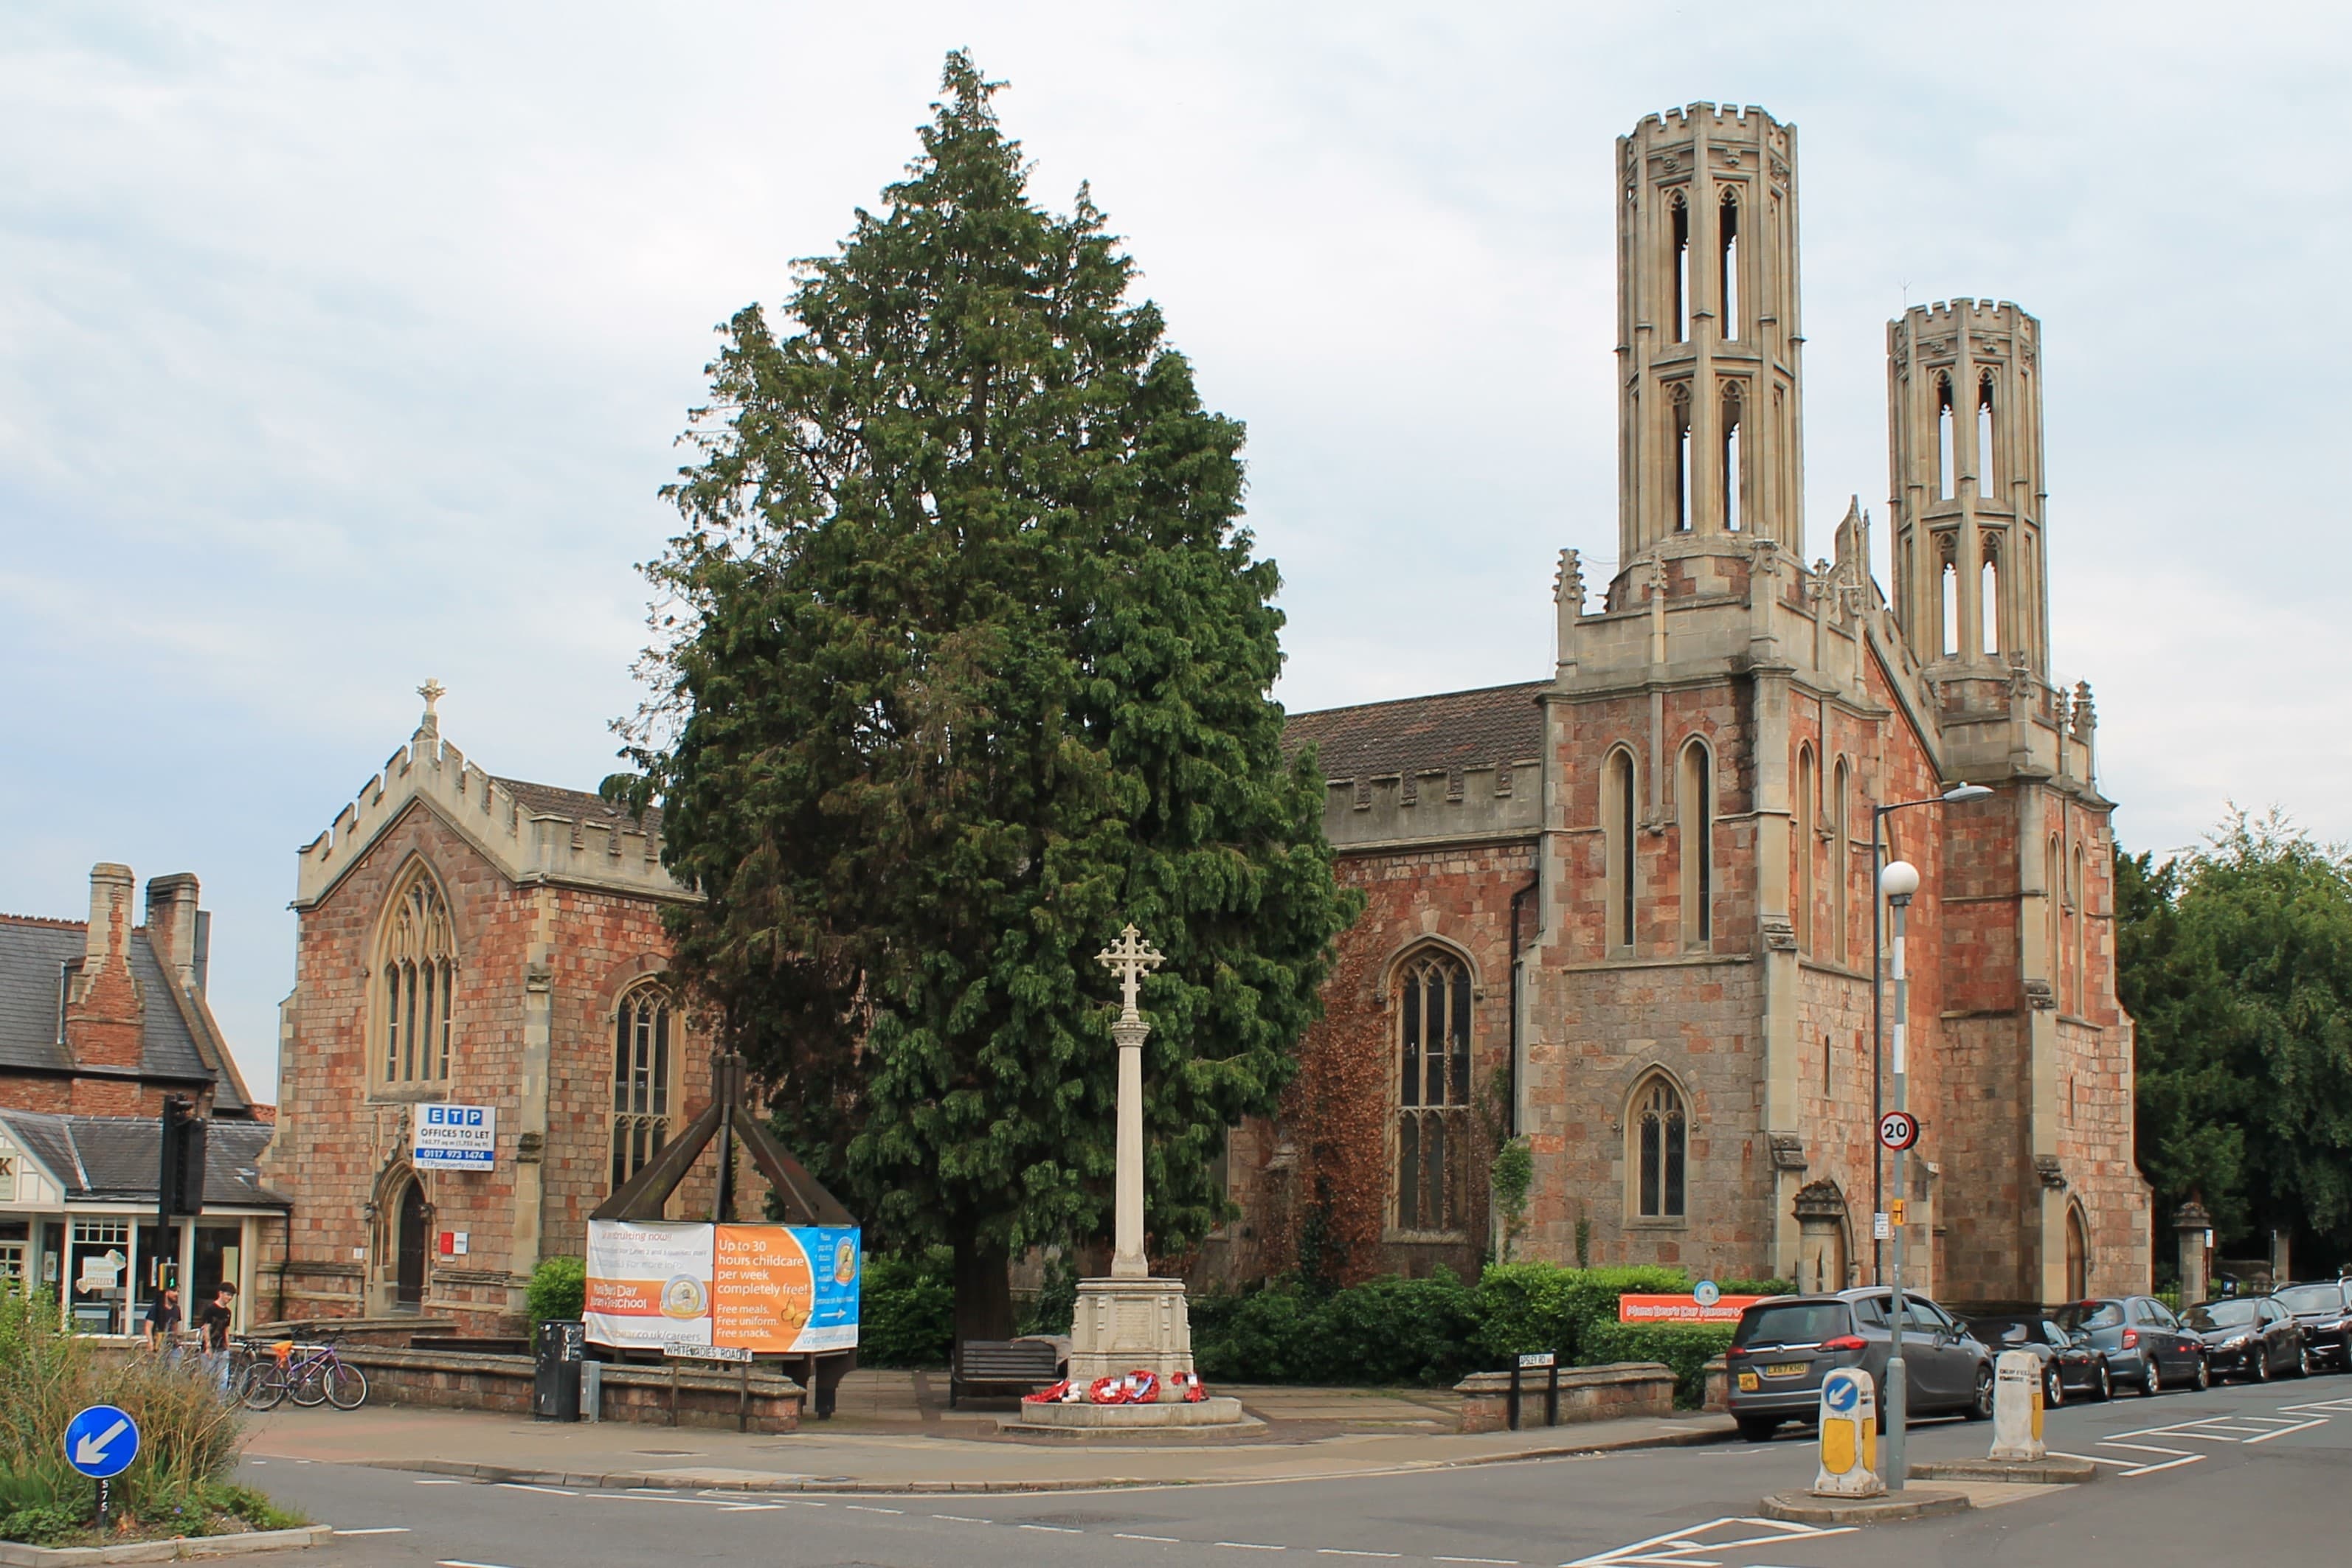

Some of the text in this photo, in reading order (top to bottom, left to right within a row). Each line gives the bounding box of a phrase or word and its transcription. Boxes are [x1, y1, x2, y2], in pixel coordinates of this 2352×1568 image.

[432, 1110, 480, 1123] ETP
[421, 1128, 457, 1137] OFFICES
[1884, 1123, 1907, 1138] 20
[424, 1150, 485, 1159] 0117 973 1474
[719, 1240, 767, 1252] Up to 30
[719, 1254, 803, 1266] hours childcare
[718, 1269, 769, 1282] per week
[617, 1285, 637, 1297] Day
[717, 1283, 808, 1298] completely free!
[717, 1304, 769, 1314] Free meals.
[716, 1316, 779, 1326] Free uniform.
[716, 1328, 772, 1338] Free snacks.
[720, 1349, 741, 1360] ROAD
